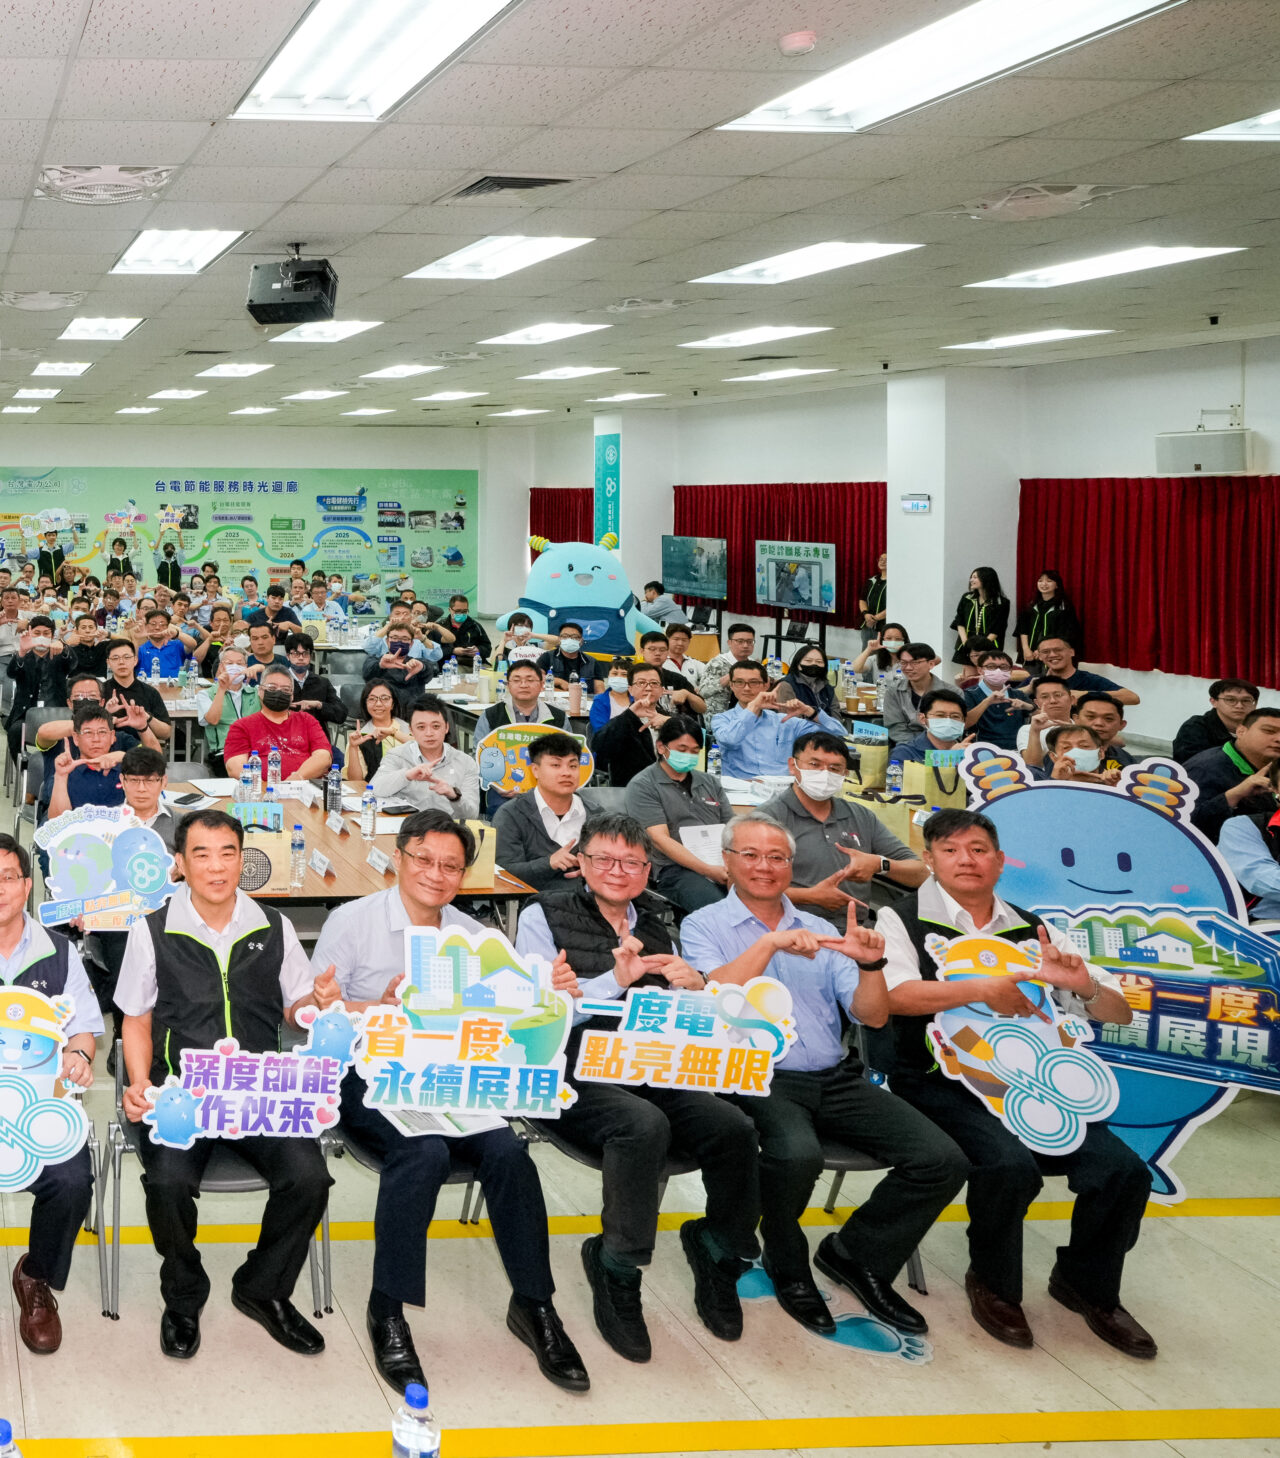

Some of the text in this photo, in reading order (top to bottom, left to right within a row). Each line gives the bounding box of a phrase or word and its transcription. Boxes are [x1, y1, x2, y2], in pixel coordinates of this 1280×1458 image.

[154, 480, 299, 493] 台電節能服務時光迴廊
[580, 990, 720, 1037] 一度電
[1117, 974, 1261, 1026] 省一度
[365, 1012, 504, 1063] 省一度
[182, 1053, 339, 1094] 深度節能
[370, 1061, 560, 1112] 永續展現
[580, 1034, 772, 1092] 點亮無限
[200, 1095, 316, 1134] 作伙來
